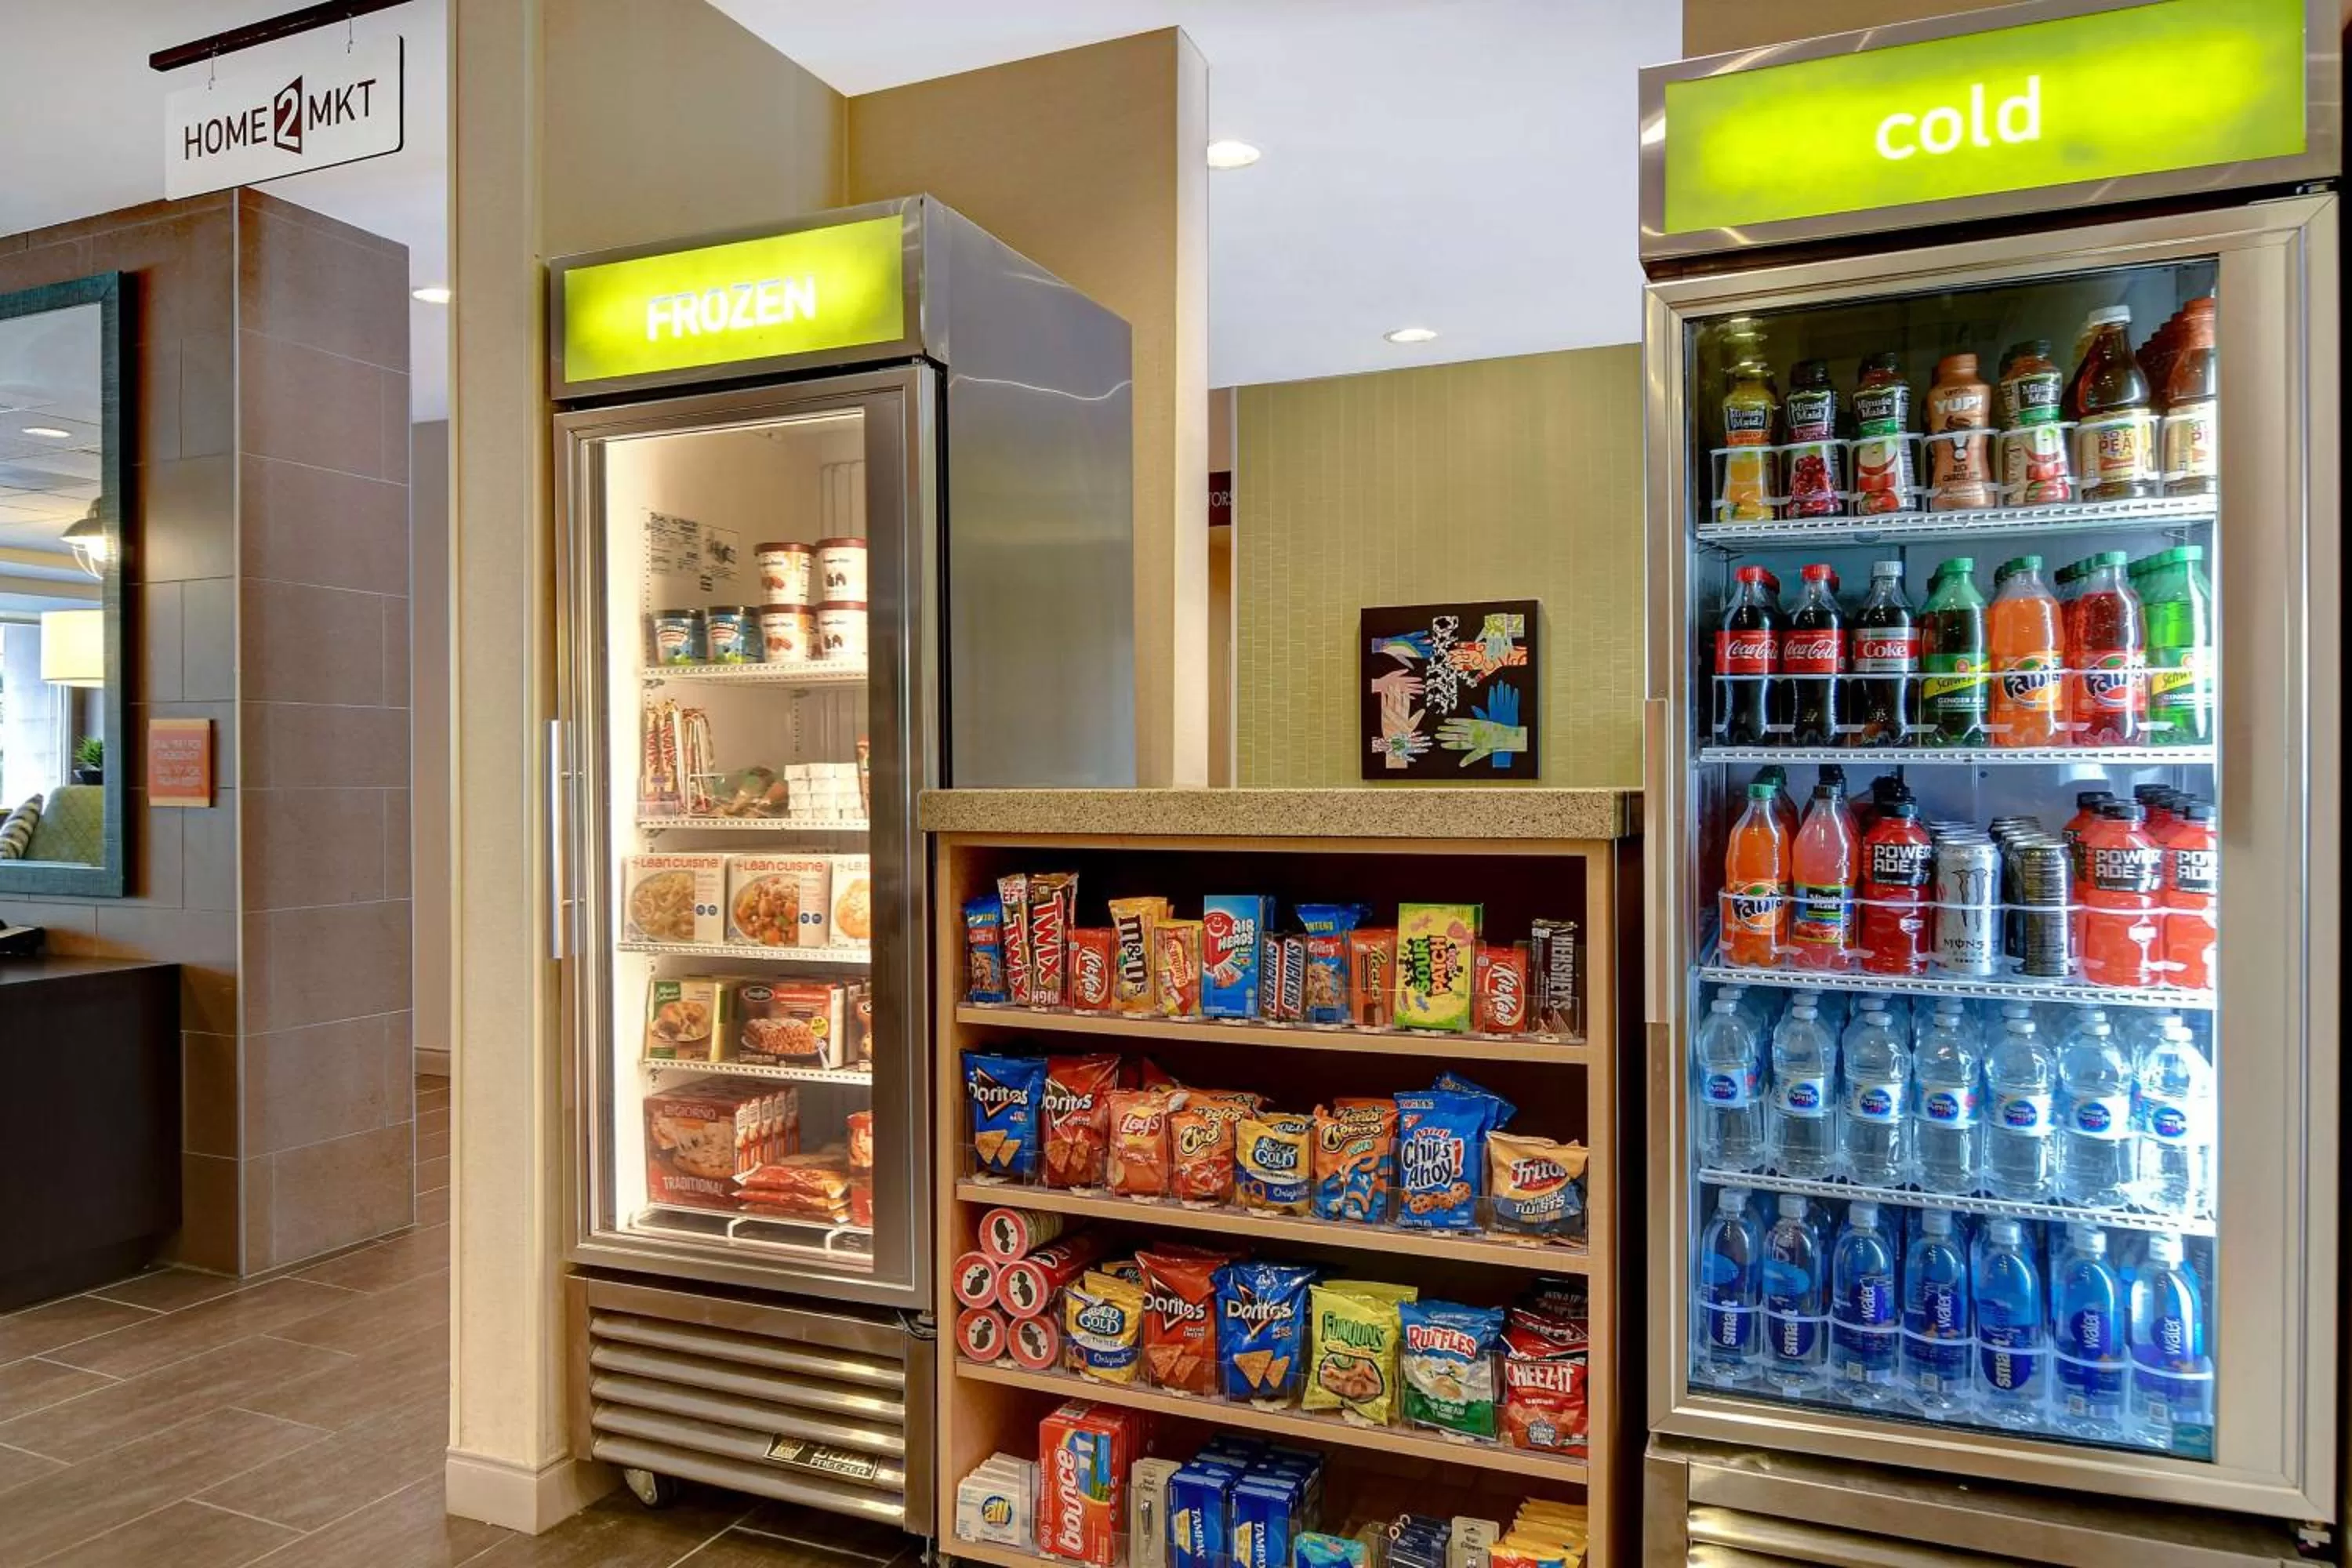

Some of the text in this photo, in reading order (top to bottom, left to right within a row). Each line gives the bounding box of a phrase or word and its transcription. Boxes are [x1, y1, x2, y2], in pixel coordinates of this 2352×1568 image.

[1875, 74, 2042, 160] cold
[646, 273, 816, 342] FROZEN
[2099, 437, 2134, 453] PEA
[1863, 641, 1907, 659] Coke
[1874, 859, 1911, 873] ADE
[1875, 844, 1932, 859] POWER
[2095, 849, 2161, 864] POWER
[2095, 865, 2136, 878] ADE
[1033, 890, 1064, 985] TWIX
[1944, 938, 1985, 949] MONS
[1283, 939, 1302, 1012] SNICKERS
[1412, 938, 1430, 993] SOUR
[1429, 935, 1448, 996] PATCH
[1255, 1149, 1295, 1167] GOLD
[1403, 1139, 1451, 1168] Chips
[662, 1175, 724, 1197] TRADITIONAL
[1144, 1291, 1206, 1320] Doritos
[1227, 1299, 1292, 1320] Doritos
[1079, 1313, 1120, 1334] GOLD
[2082, 1311, 2100, 1349] water
[2163, 1317, 2183, 1356] water
[1407, 1324, 1477, 1359] RUFFLES
[1505, 1361, 1575, 1393] CHEEZ-IT
[984, 1500, 1010, 1523] all
[1055, 1446, 1083, 1553] bounce
[1254, 1522, 1266, 1568] TAMPA
